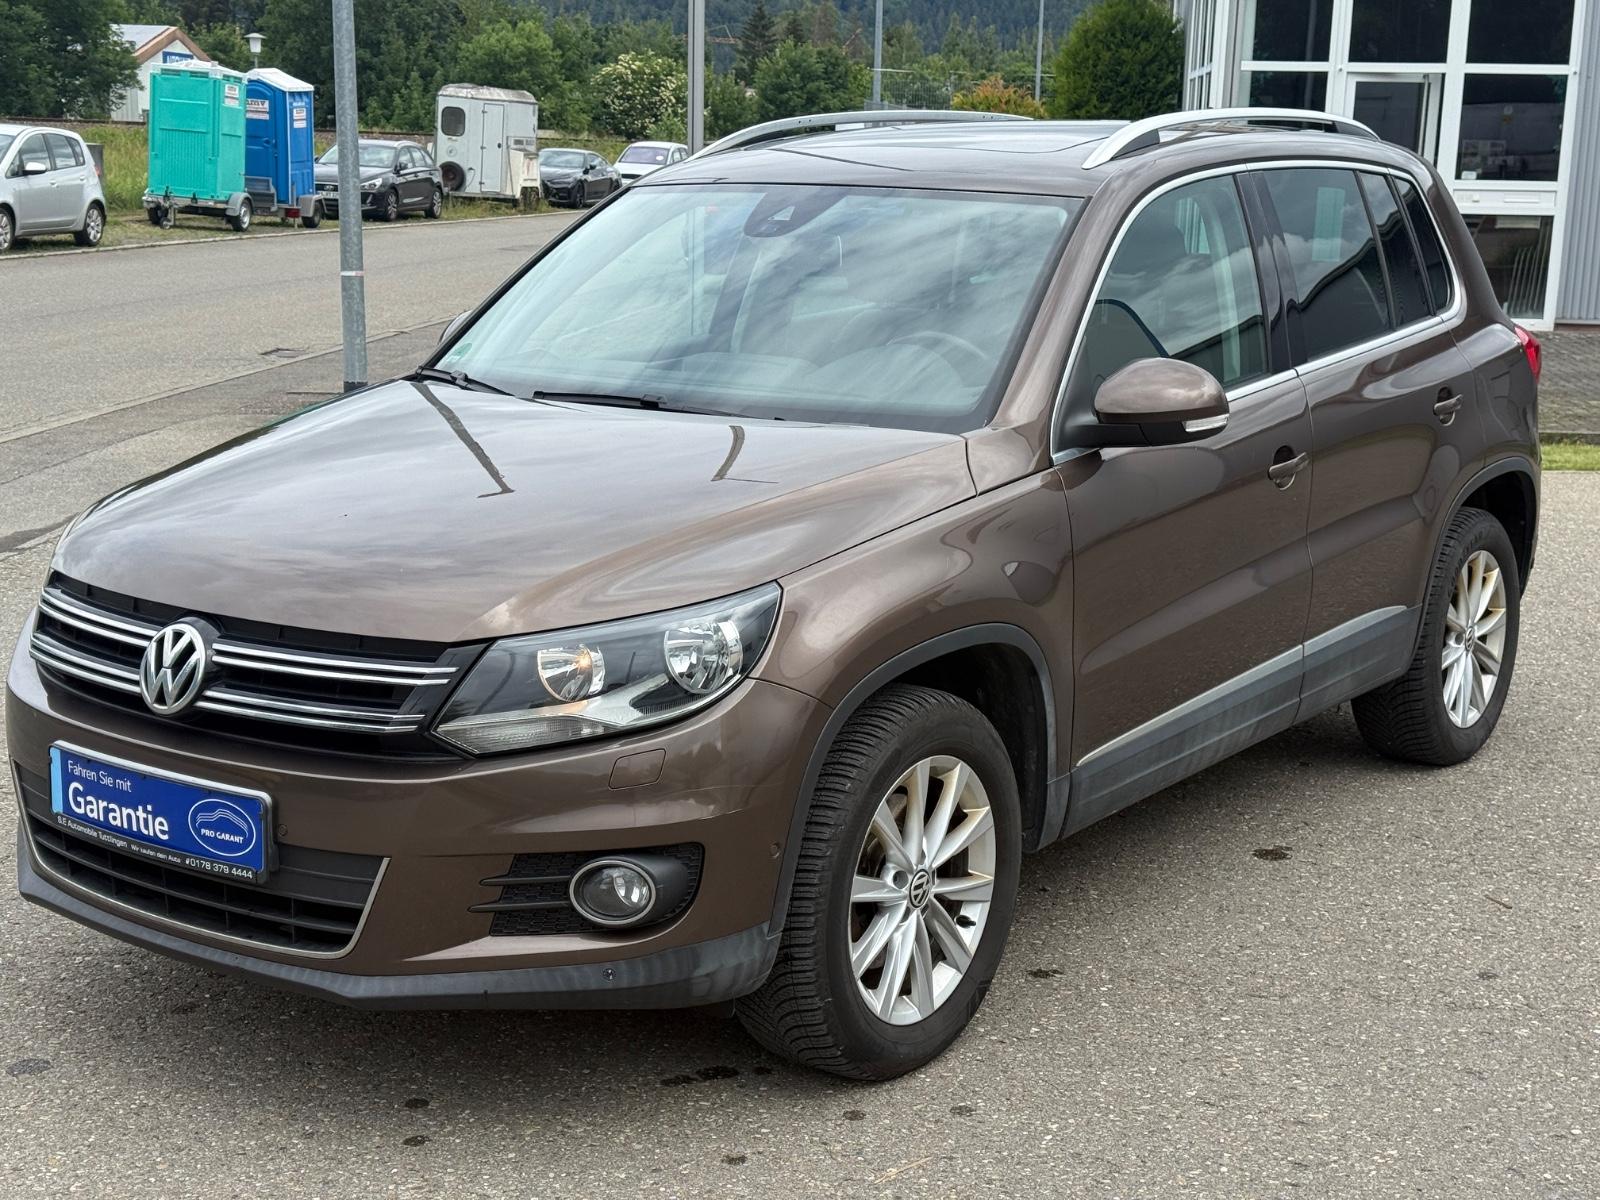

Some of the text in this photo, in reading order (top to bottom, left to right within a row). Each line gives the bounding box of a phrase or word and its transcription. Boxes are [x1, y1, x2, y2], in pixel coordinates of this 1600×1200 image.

[67, 760, 132, 793] Fahren Sie mit
[68, 782, 169, 840] Garantie
[67, 820, 98, 837] Automobile
[98, 831, 127, 848] Tuttlingen
[213, 863, 229, 874] 379
[231, 867, 253, 879] 4444
[200, 828, 244, 844] PRO GARANT
